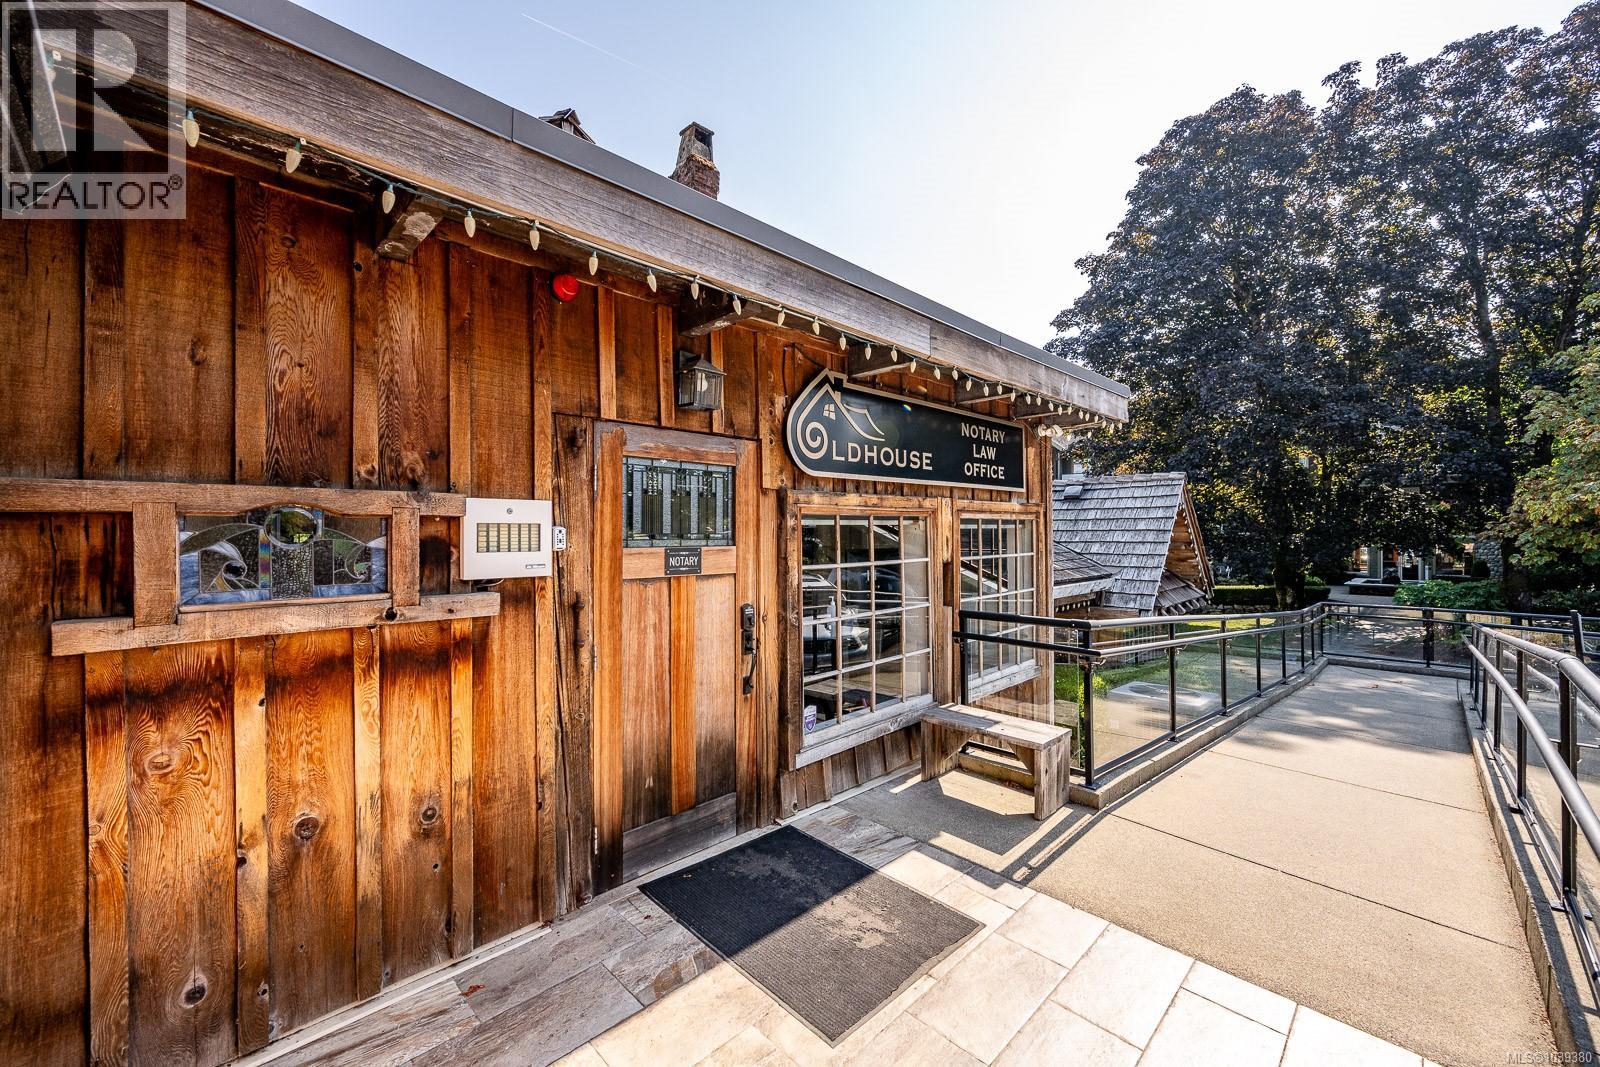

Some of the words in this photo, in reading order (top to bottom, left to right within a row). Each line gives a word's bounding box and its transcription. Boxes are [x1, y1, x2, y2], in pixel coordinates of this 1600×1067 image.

[961, 422, 1006, 444] NOTARY
[973, 444, 996, 461] LAW
[964, 465, 1005, 480] OFFICE
[669, 556, 699, 567] NOTARY
